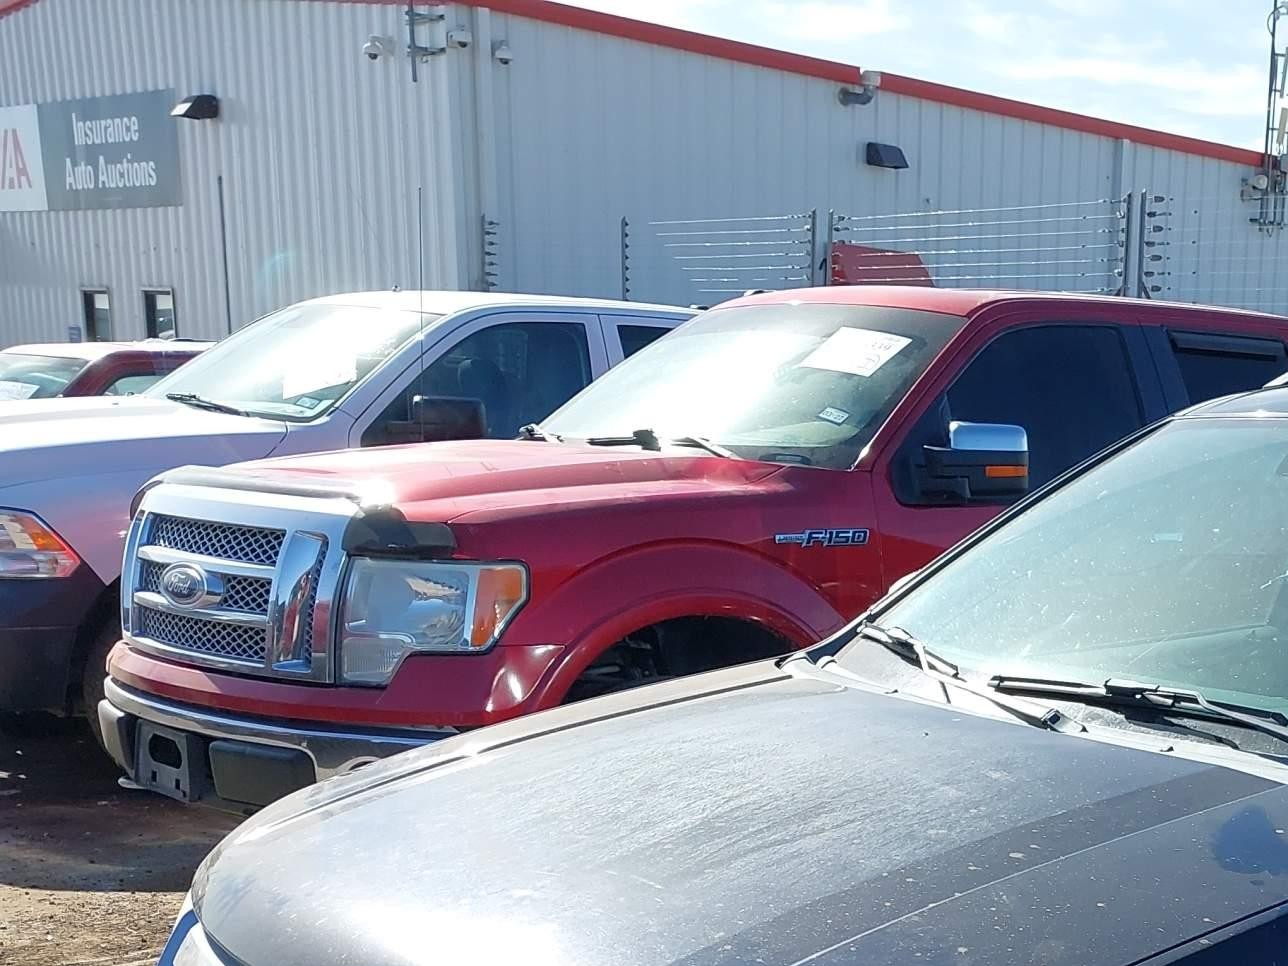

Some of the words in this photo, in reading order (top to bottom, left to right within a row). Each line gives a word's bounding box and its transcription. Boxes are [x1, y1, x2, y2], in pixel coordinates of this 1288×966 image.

[72, 112, 140, 146] Insurance
[65, 157, 96, 191] Auto
[98, 153, 158, 189] Auctions
[802, 528, 870, 546] F-150
[167, 573, 191, 594] Ford
